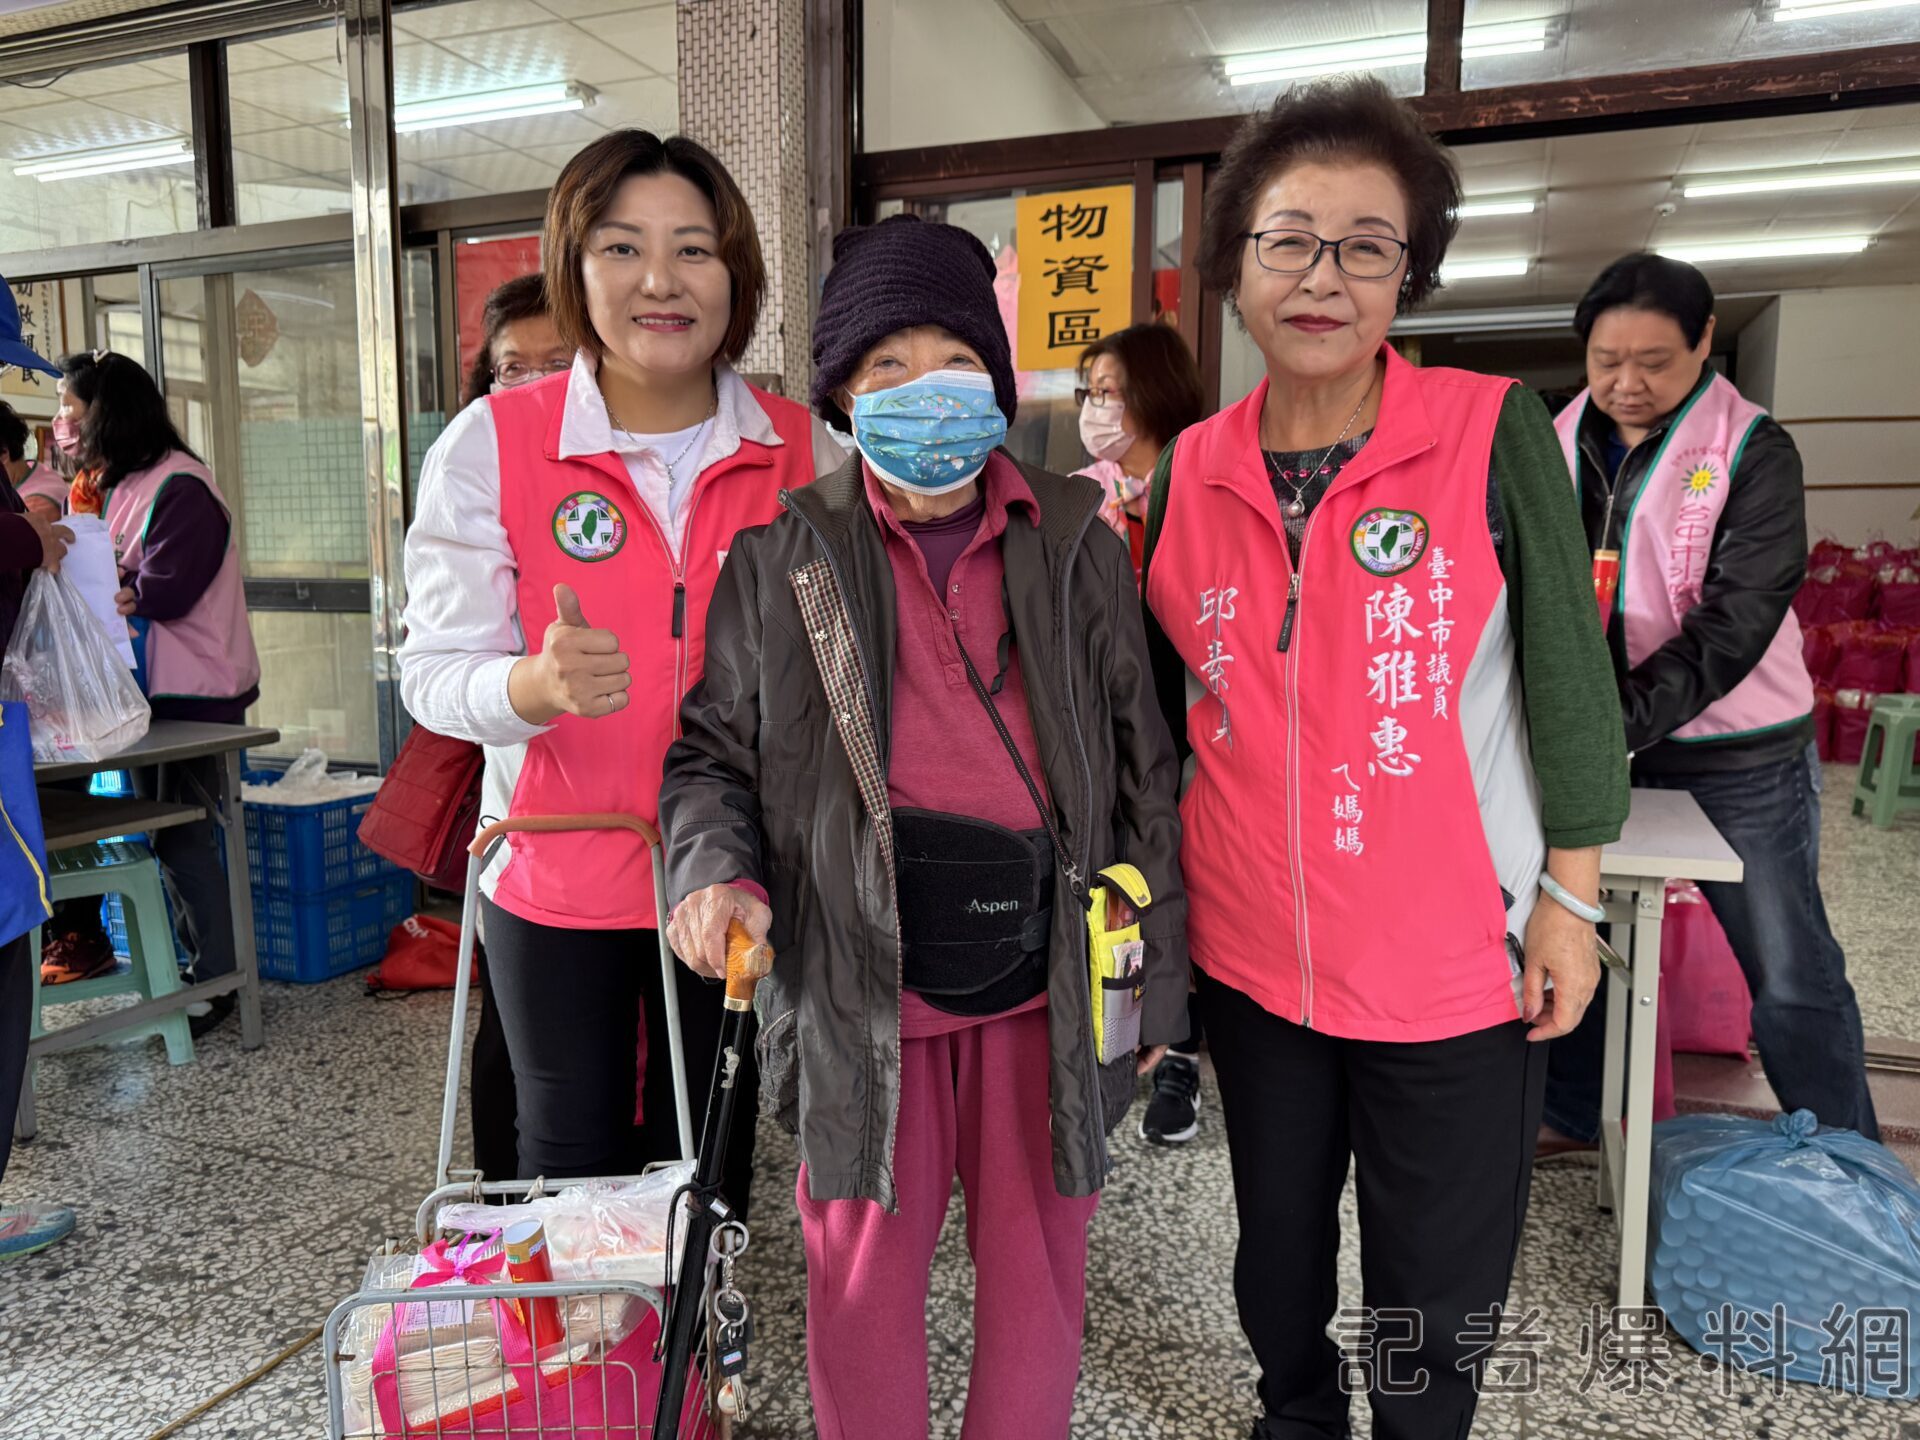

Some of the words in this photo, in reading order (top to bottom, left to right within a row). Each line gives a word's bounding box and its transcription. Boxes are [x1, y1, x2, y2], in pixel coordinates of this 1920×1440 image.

[1039, 203, 1109, 350] 物資區
[1364, 582, 1424, 777] 陳雅惠
[1425, 546, 1455, 720] 臺中市議員
[965, 898, 1019, 915] Aspen
